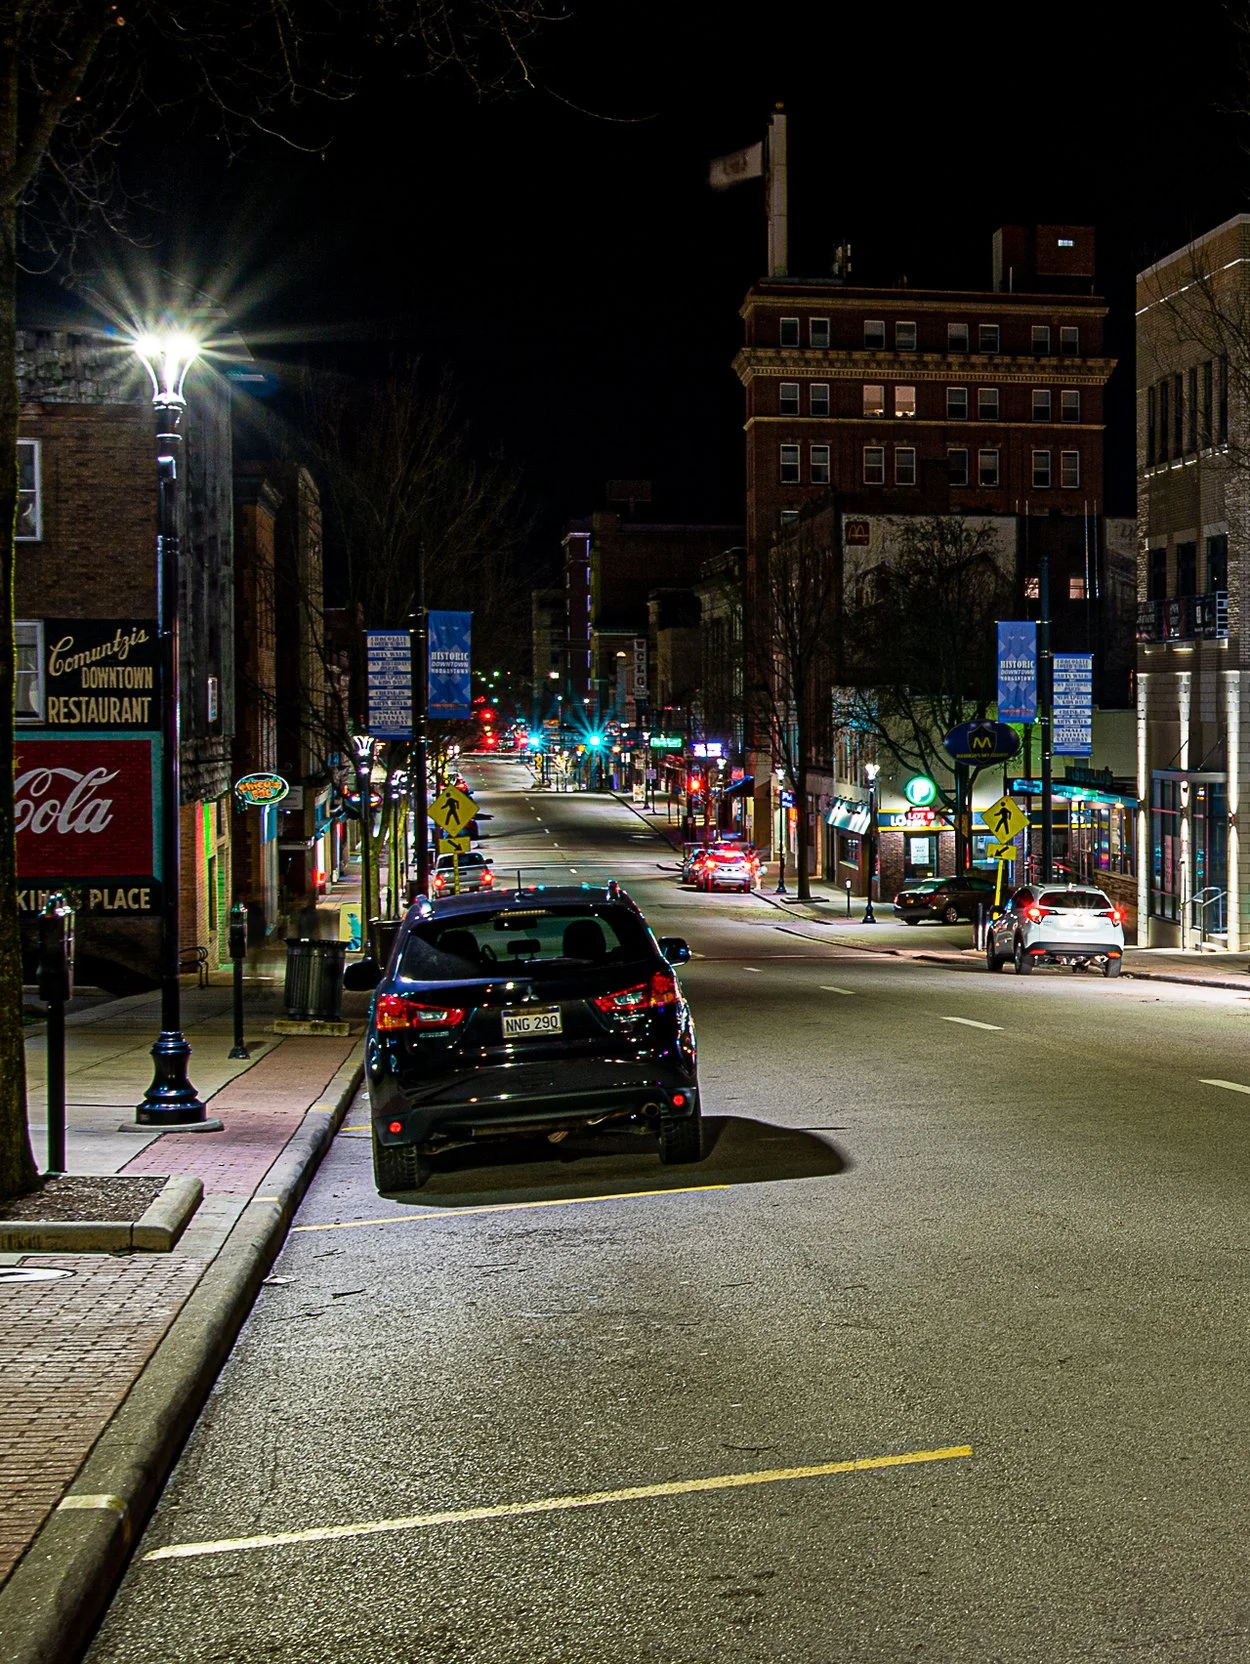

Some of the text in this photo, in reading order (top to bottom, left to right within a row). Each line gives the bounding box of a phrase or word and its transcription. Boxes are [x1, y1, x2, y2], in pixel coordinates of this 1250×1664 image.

[431, 652, 469, 661] HISTORIC
[1000, 660, 1035, 669] HISTORIC
[81, 667, 153, 689] DOWNTOWN
[48, 697, 152, 724] RESTAURANT
[908, 812, 926, 820] LOT
[89, 888, 151, 910] PLACE
[506, 1017, 530, 1031] NNG
